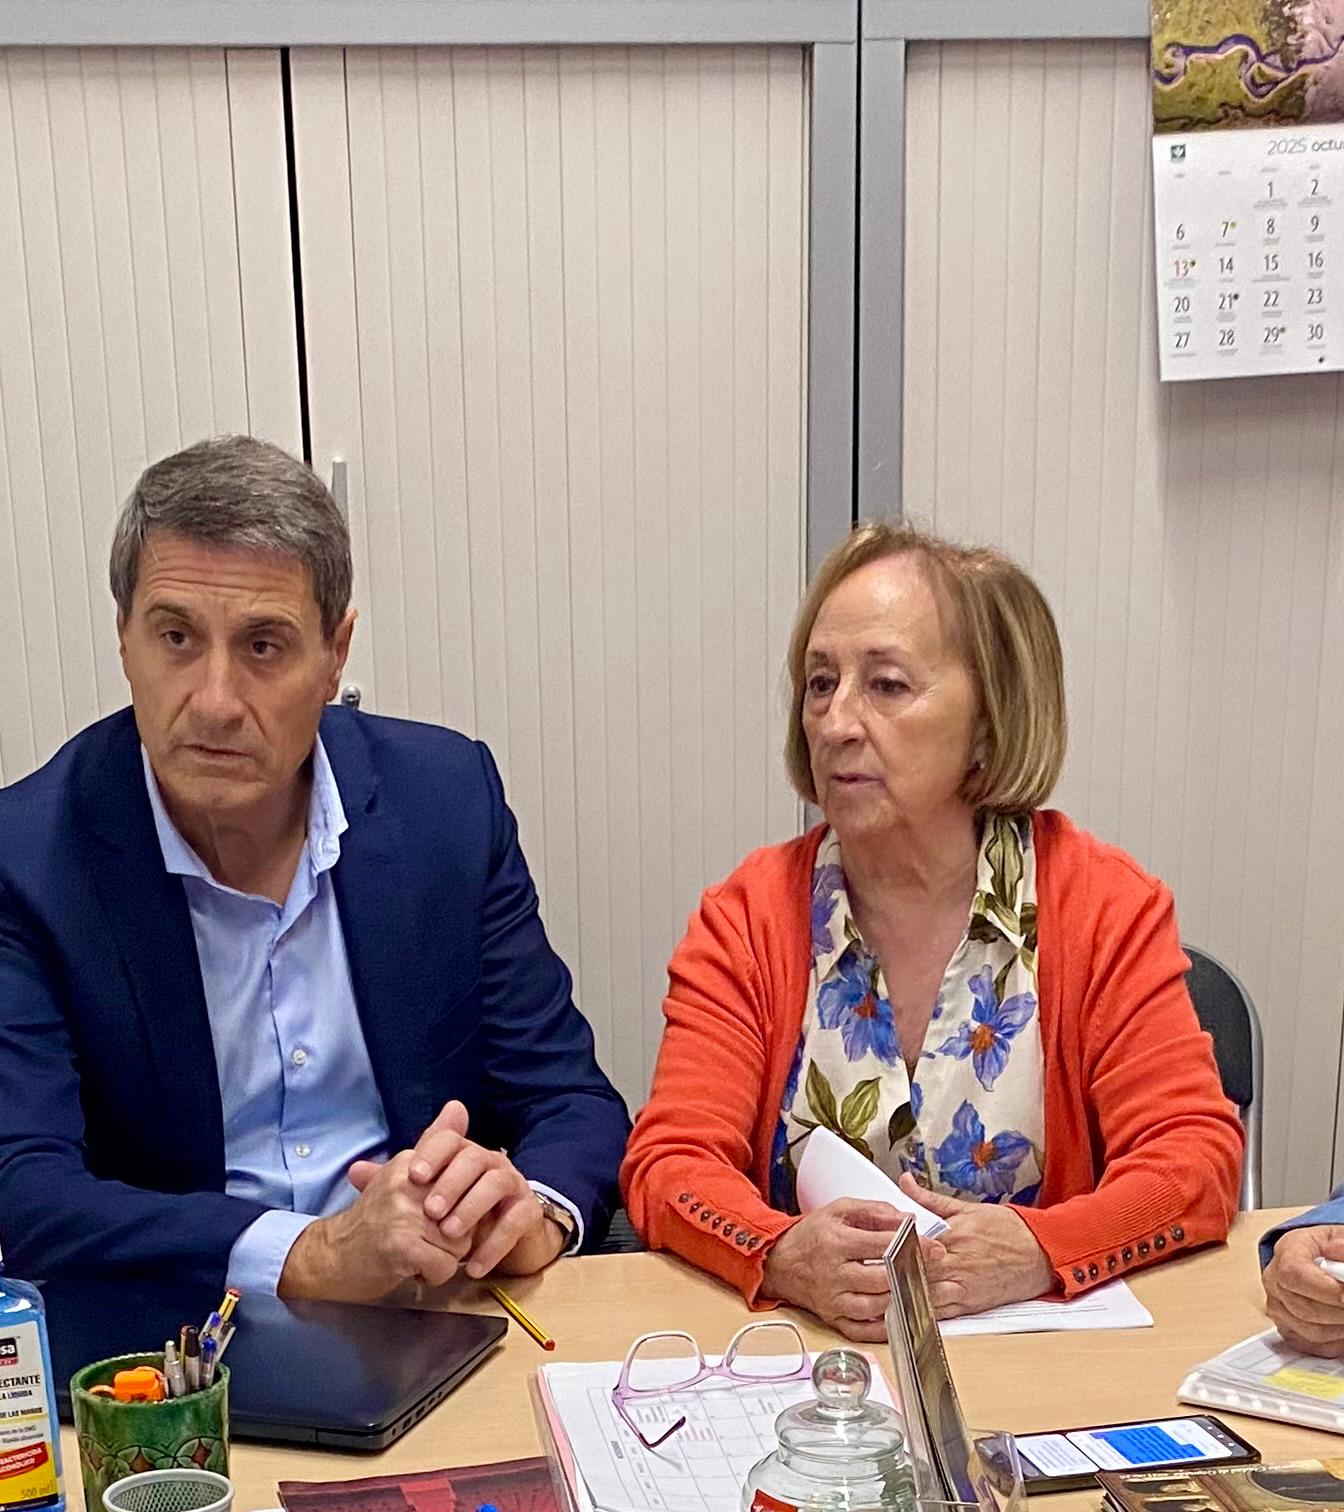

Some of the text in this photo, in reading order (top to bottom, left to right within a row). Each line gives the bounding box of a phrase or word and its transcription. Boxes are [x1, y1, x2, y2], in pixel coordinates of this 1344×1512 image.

[1267, 137, 1306, 156] 2025
[1268, 181, 1274, 198] 1
[1310, 180, 1319, 196] 2
[1176, 223, 1185, 240] 6
[1222, 221, 1229, 237] 7
[1266, 218, 1275, 235] 8
[1311, 216, 1319, 232] 9
[1174, 259, 1190, 277] 13
[1219, 256, 1234, 274] 14
[1264, 254, 1279, 271] 15
[1308, 252, 1323, 268] 16
[1174, 296, 1190, 313] 20
[1219, 293, 1233, 310] 21
[1263, 290, 1279, 307] 22
[1307, 288, 1323, 305] 23
[1175, 331, 1190, 348] 27
[1219, 329, 1235, 346] 28
[1264, 326, 1280, 344] 29
[1307, 324, 1323, 341] 30
